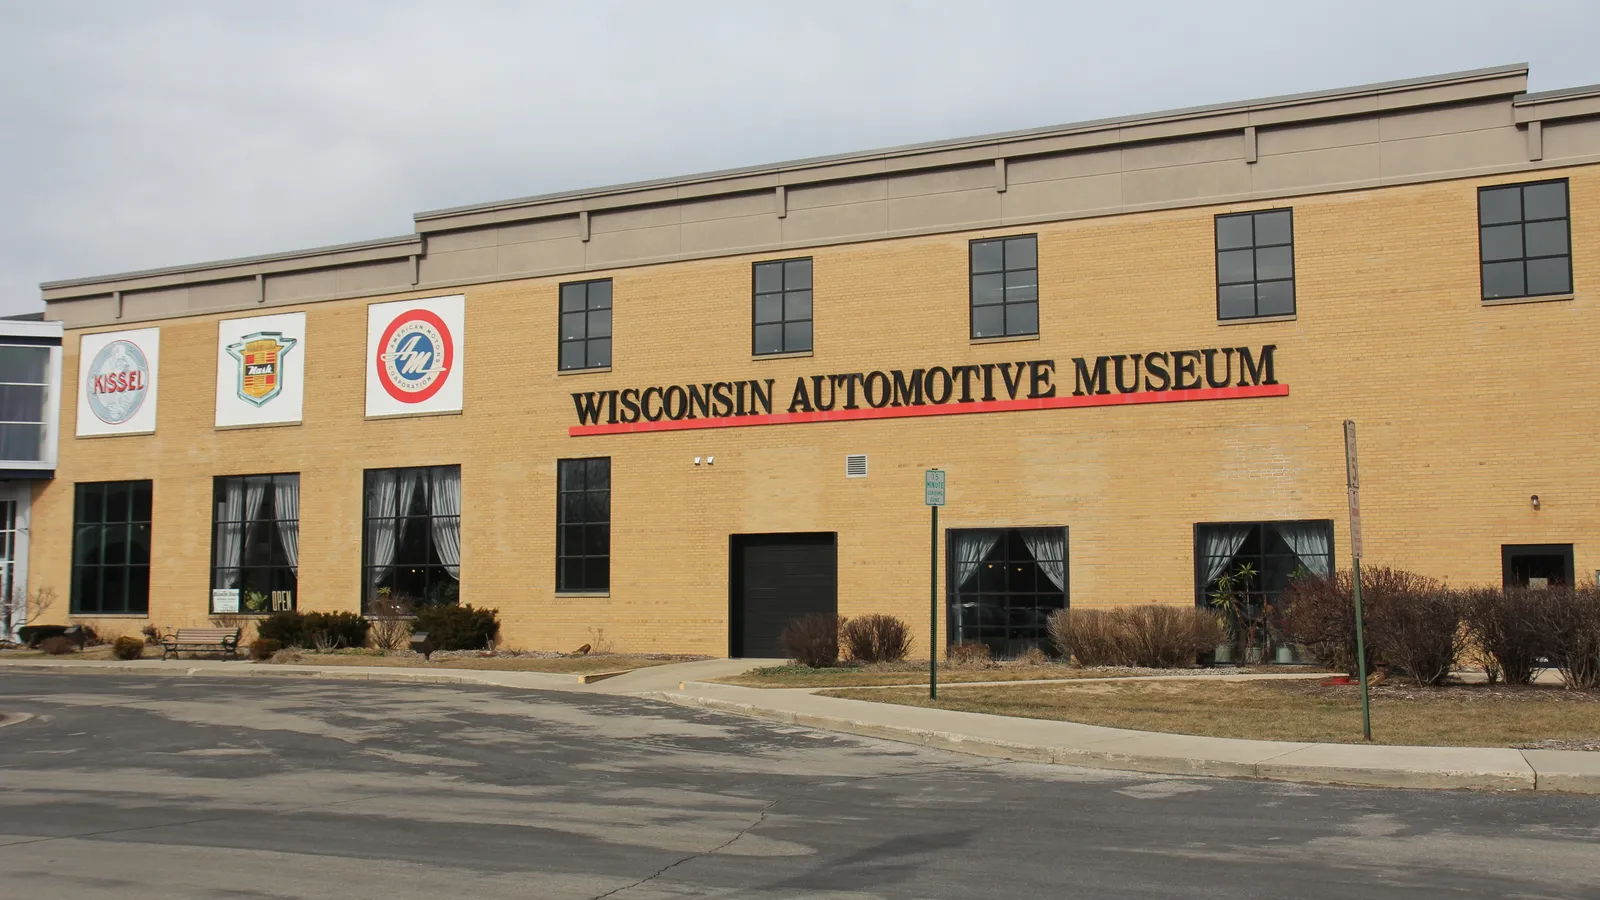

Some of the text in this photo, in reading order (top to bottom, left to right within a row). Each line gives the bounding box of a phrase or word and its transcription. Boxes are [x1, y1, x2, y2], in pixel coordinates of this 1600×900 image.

[390, 324, 441, 363] AMERICAN MOTORS
[247, 364, 273, 375] Nash
[388, 365, 432, 389] CORPORATION
[93, 370, 144, 394] KISSEL
[570, 344, 1279, 425] WISCONSIN AUTOMOTIVE MUSEUM
[271, 590, 292, 611] OPEN
